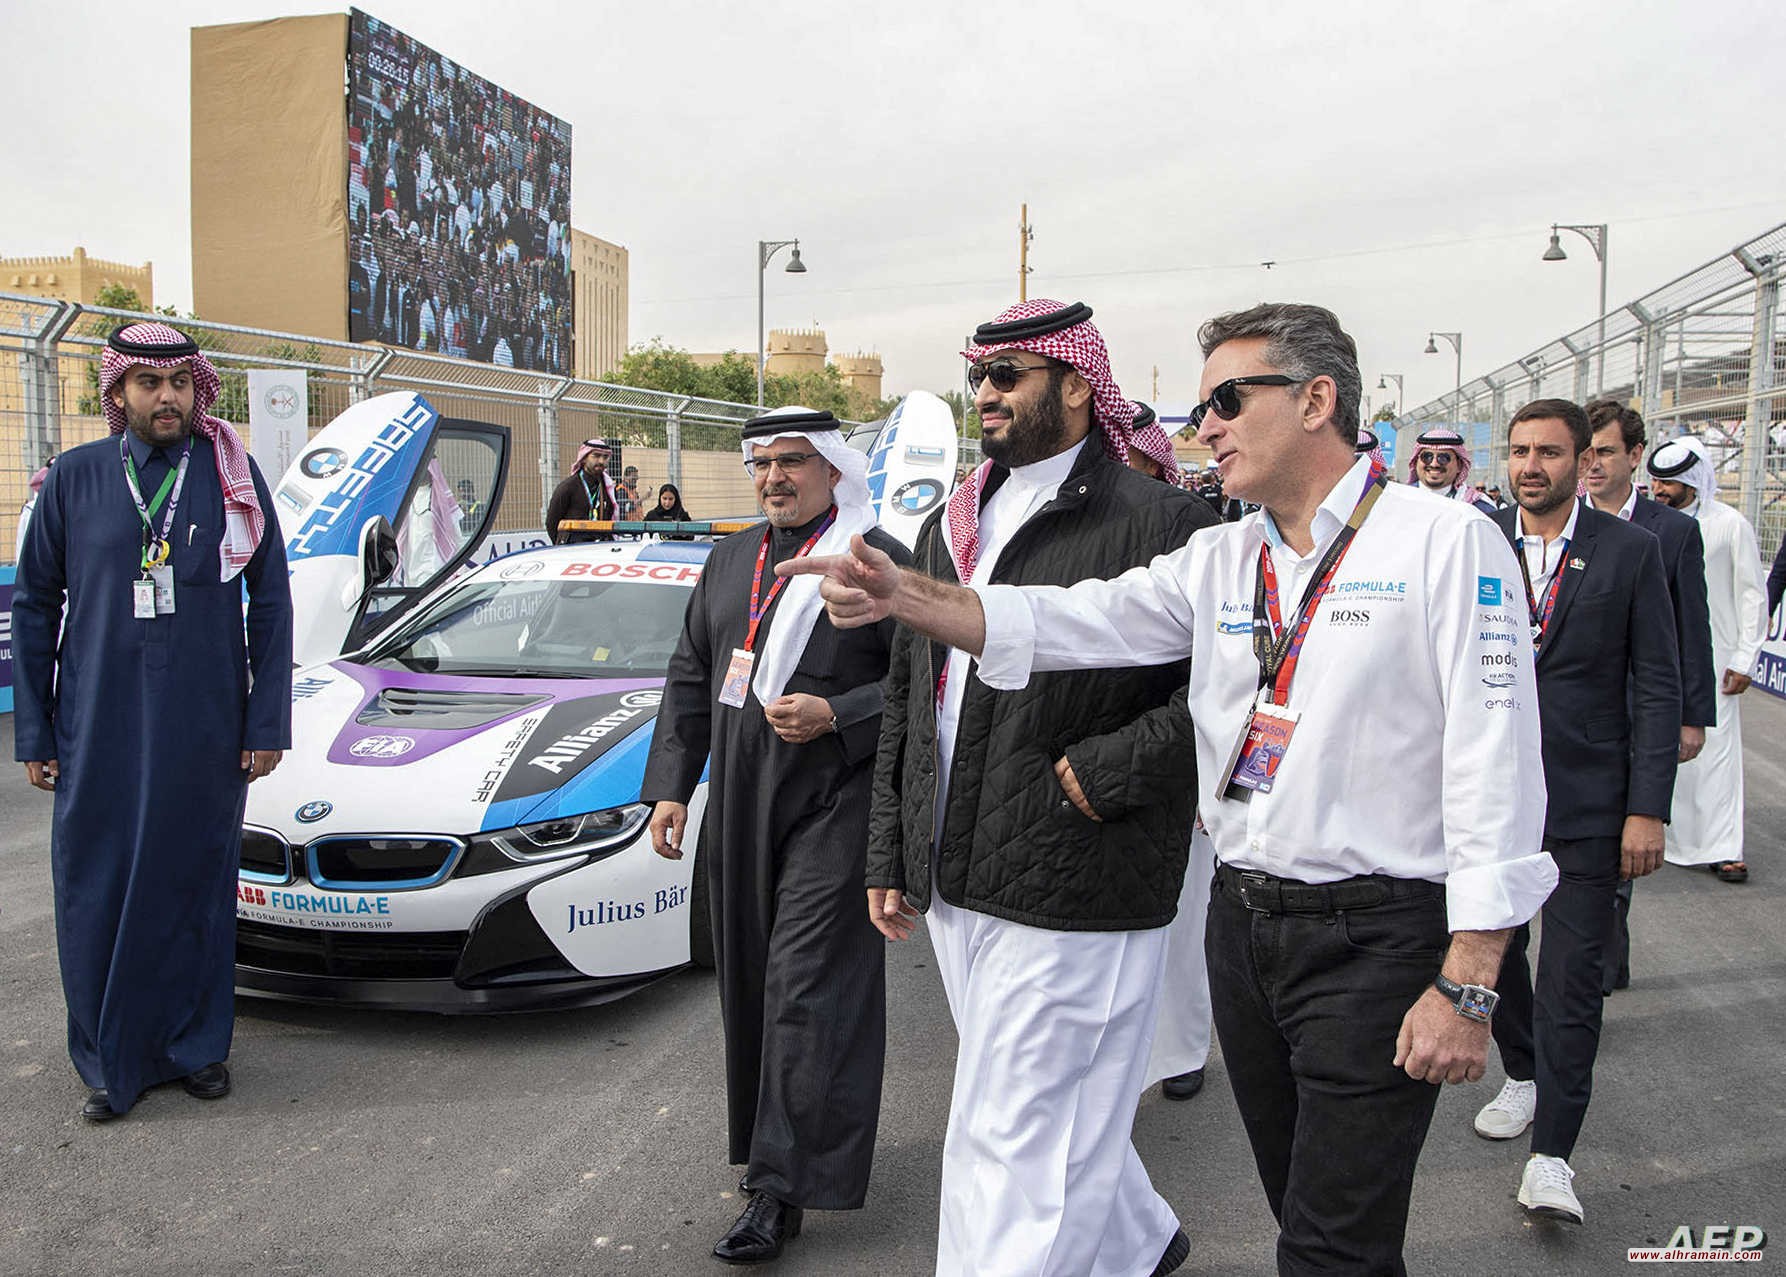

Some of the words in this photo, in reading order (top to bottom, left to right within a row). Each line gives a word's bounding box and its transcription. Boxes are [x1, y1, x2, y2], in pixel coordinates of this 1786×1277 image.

[1330, 609, 1370, 623] BOSS
[1479, 631, 1511, 641] Allianz
[528, 708, 643, 774] Allianz
[271, 890, 390, 914] FORMULA-E
[568, 900, 645, 933] Julius
[654, 885, 688, 915] Bär
[310, 919, 393, 929] CHAMPIONSHIP
